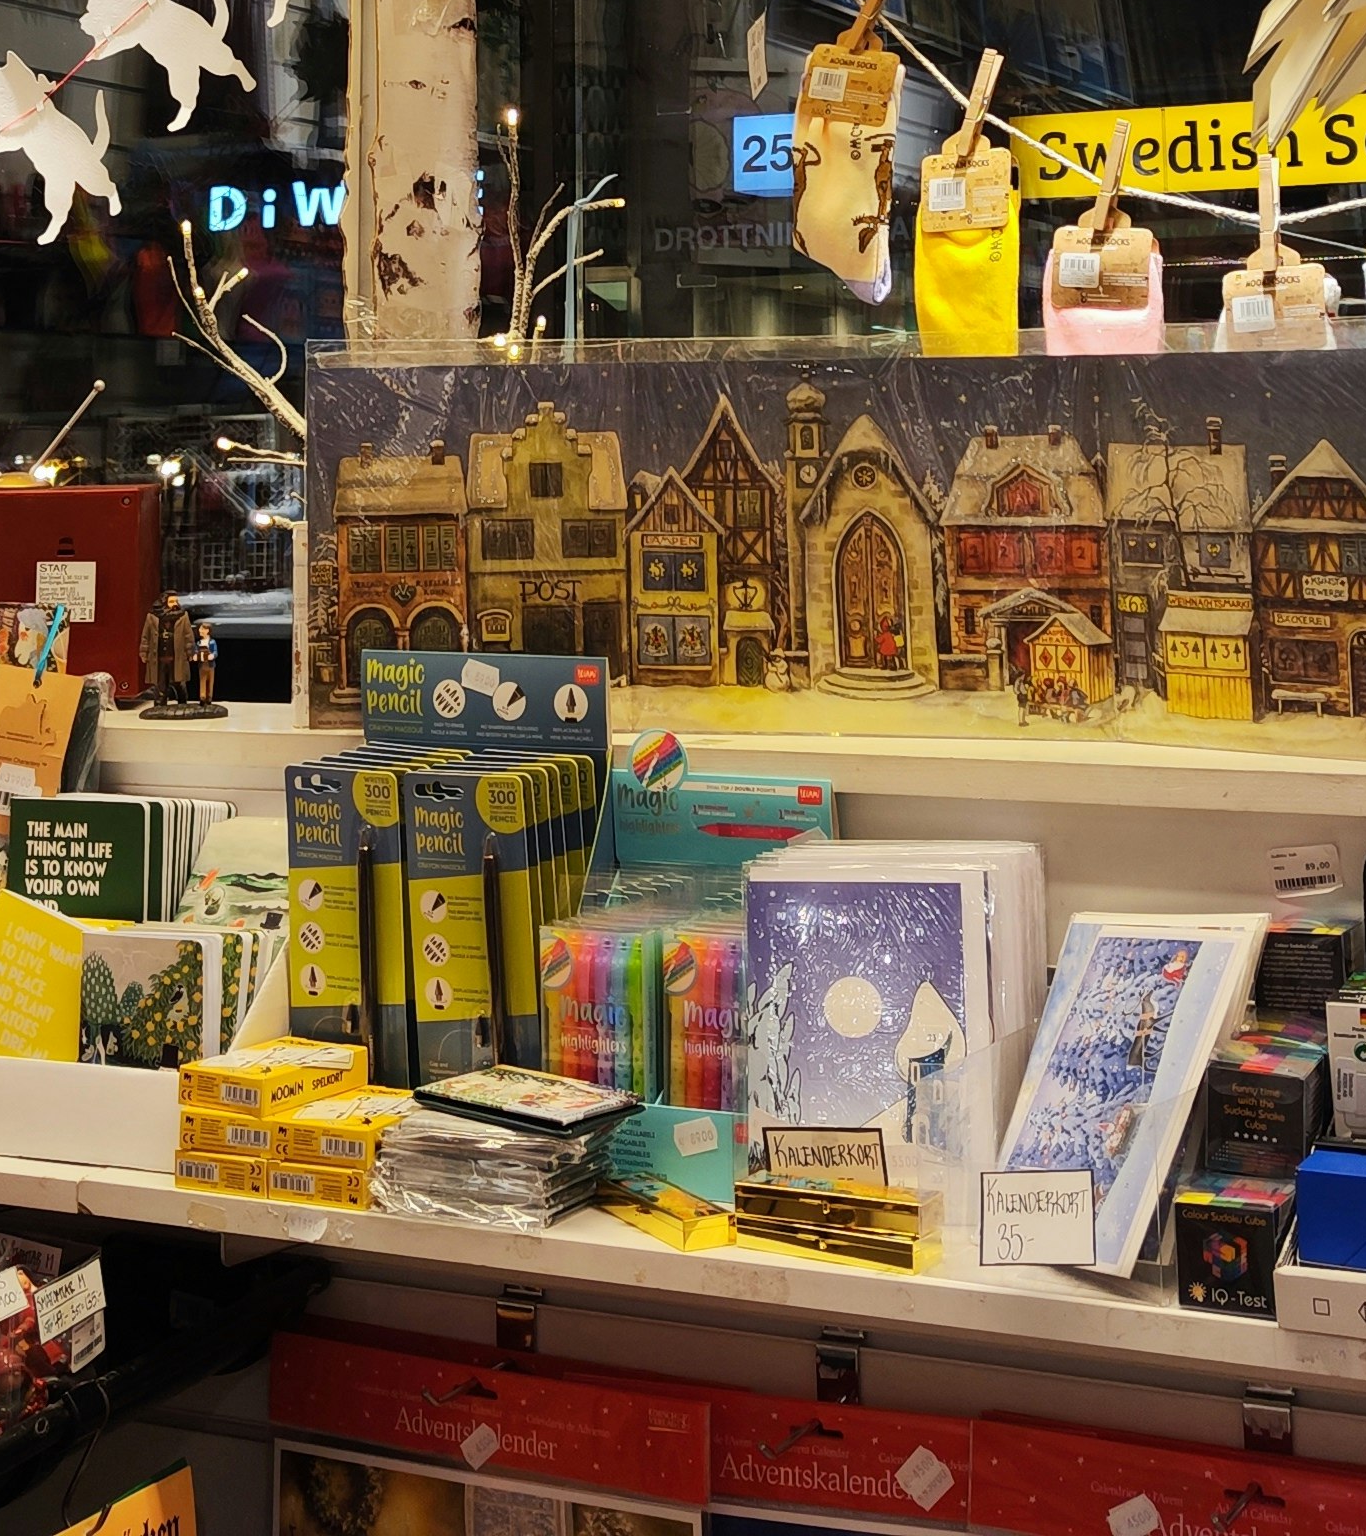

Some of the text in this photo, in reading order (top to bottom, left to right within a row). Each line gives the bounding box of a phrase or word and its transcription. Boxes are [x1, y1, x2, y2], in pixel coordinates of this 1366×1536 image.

[856, 60, 878, 71] SOCKS
[741, 133, 793, 173] 25
[1039, 118, 1304, 182] Swedish
[967, 159, 990, 168] SOCKS
[1106, 237, 1130, 246] SOCKS
[1276, 275, 1301, 285] SOCKS
[644, 535, 698, 545] LAMPEN
[39, 564, 68, 575] STAR
[519, 579, 582, 602] POST
[366, 659, 425, 691] Magic
[366, 688, 424, 716] pencil
[617, 783, 680, 816] Magic
[294, 797, 342, 826] Magic
[414, 806, 464, 834] Magic
[27, 821, 88, 838] THE MAIN
[296, 821, 342, 847] pencil
[26, 840, 113, 859] THING IN LIFE
[416, 830, 465, 857] pencil
[25, 859, 107, 878] IS TO KNOW
[25, 878, 100, 896] YOUR OWN
[14, 991, 54, 1023] PLANT
[561, 995, 626, 1038] Magic
[561, 1031, 627, 1055] highlighters
[312, 1071, 344, 1090] SPELKORT
[1223, 1105, 1258, 1118] Sudoku
[1245, 1120, 1267, 1131] Cube
[773, 1134, 880, 1168] KALENDERKORT
[987, 1178, 1089, 1219] KALENDERKORT
[1182, 1208, 1267, 1227] Colour Sudoku Cube
